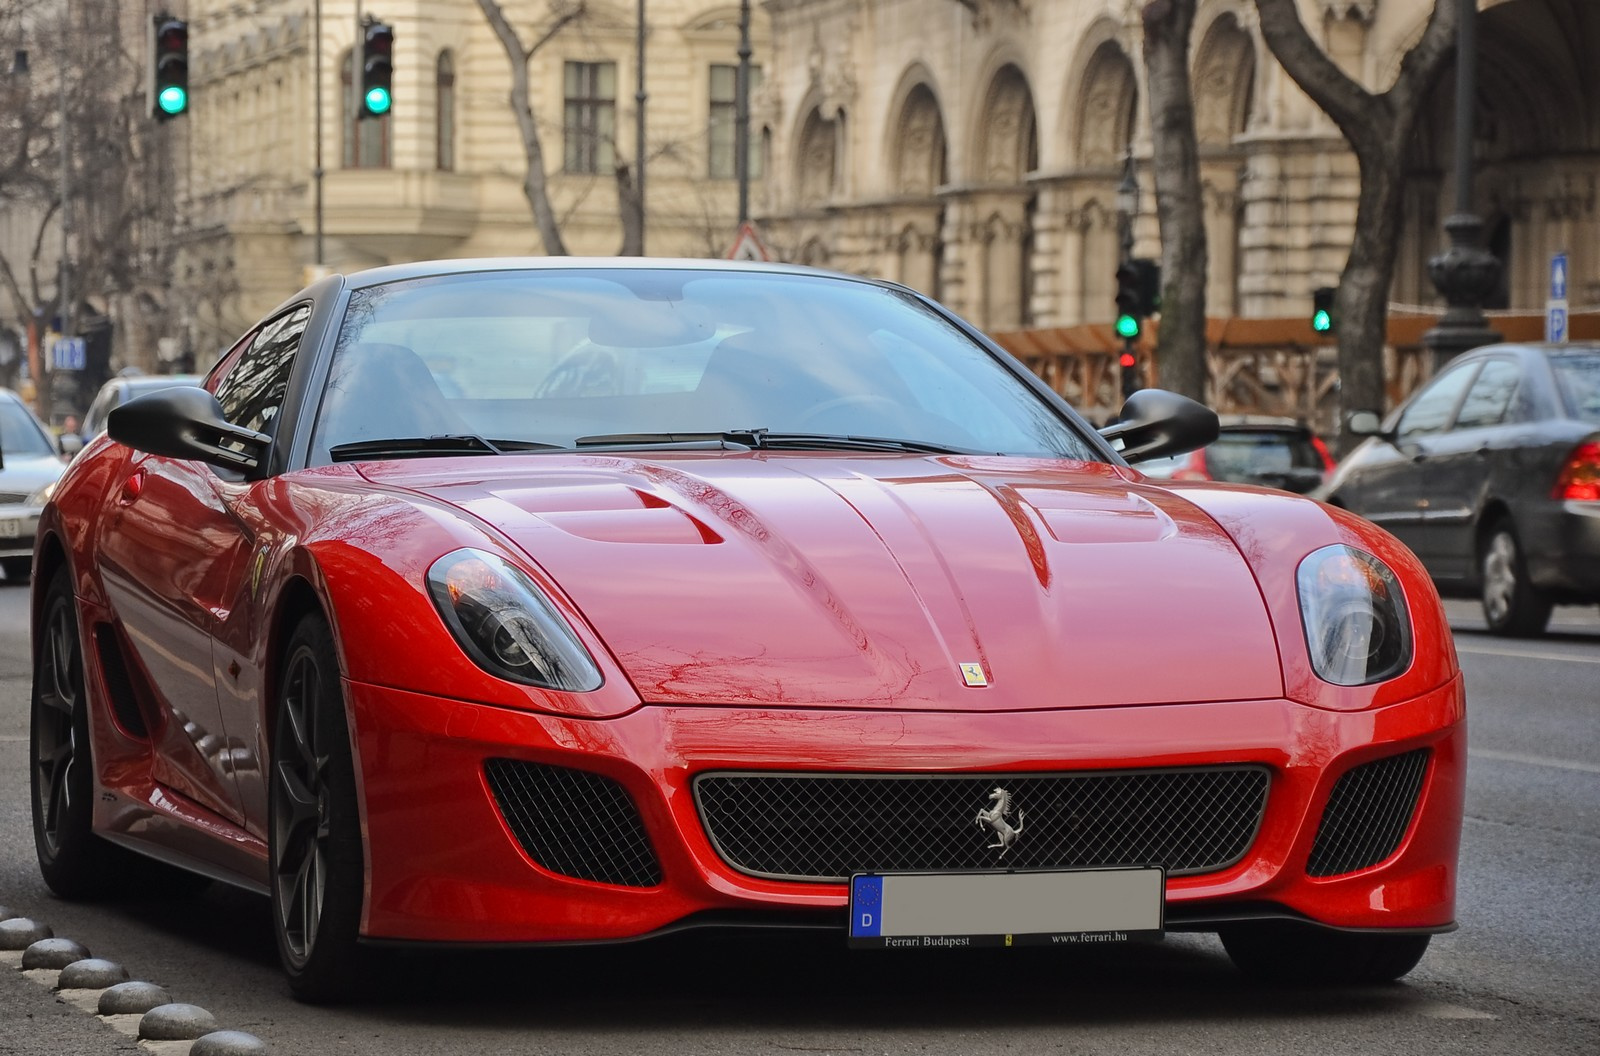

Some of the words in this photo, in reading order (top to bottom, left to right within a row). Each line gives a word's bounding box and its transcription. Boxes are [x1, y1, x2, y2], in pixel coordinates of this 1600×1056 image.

[1552, 311, 1563, 342] P
[862, 913, 872, 927] D
[885, 936, 920, 947] Ferrari
[923, 936, 970, 948] Budapest
[1051, 931, 1127, 943] www.ferrari.hu
